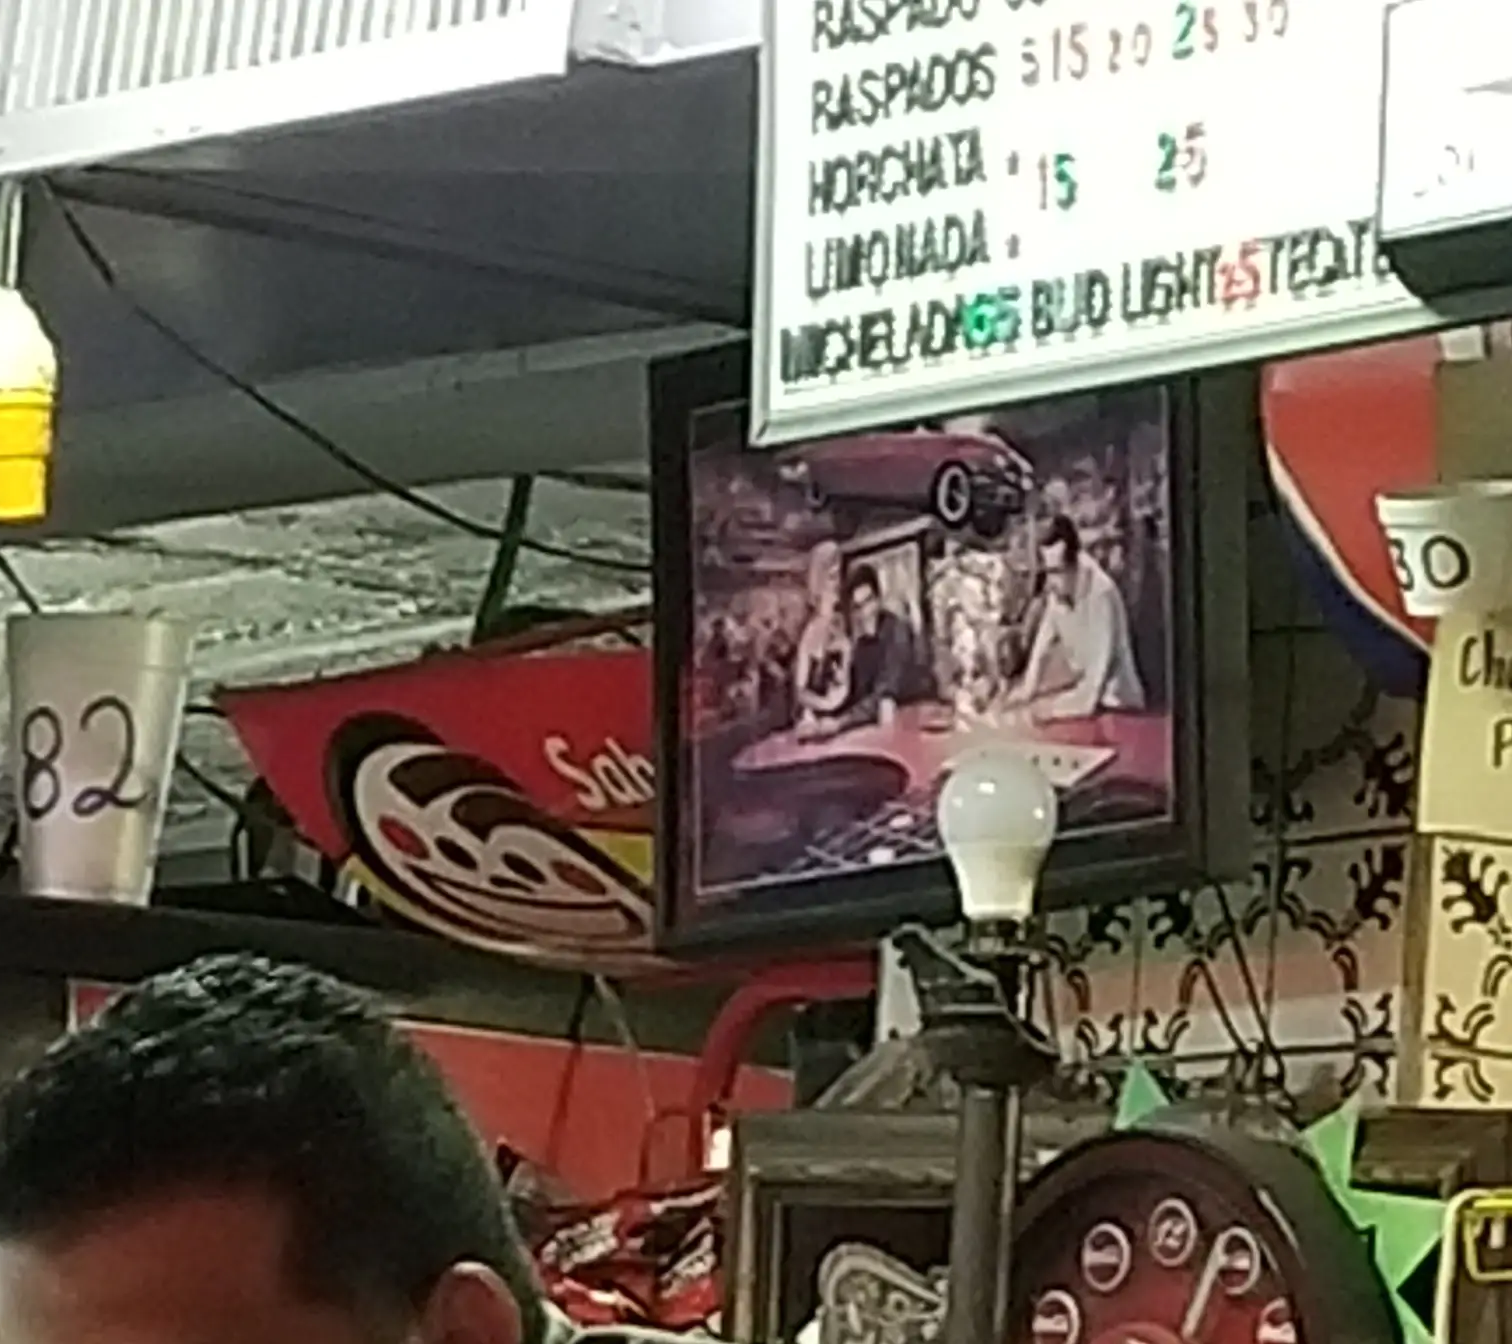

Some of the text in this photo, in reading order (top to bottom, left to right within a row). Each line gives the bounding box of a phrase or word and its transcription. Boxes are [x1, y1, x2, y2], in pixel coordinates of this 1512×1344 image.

[812, 42, 997, 134] RASPADOS
[808, 127, 987, 217] HORCHATA
[1038, 153, 1078, 210] 15
[1031, 268, 1113, 339] BUD
[1120, 243, 1223, 323] LIGHT
[20, 696, 155, 821] 82
